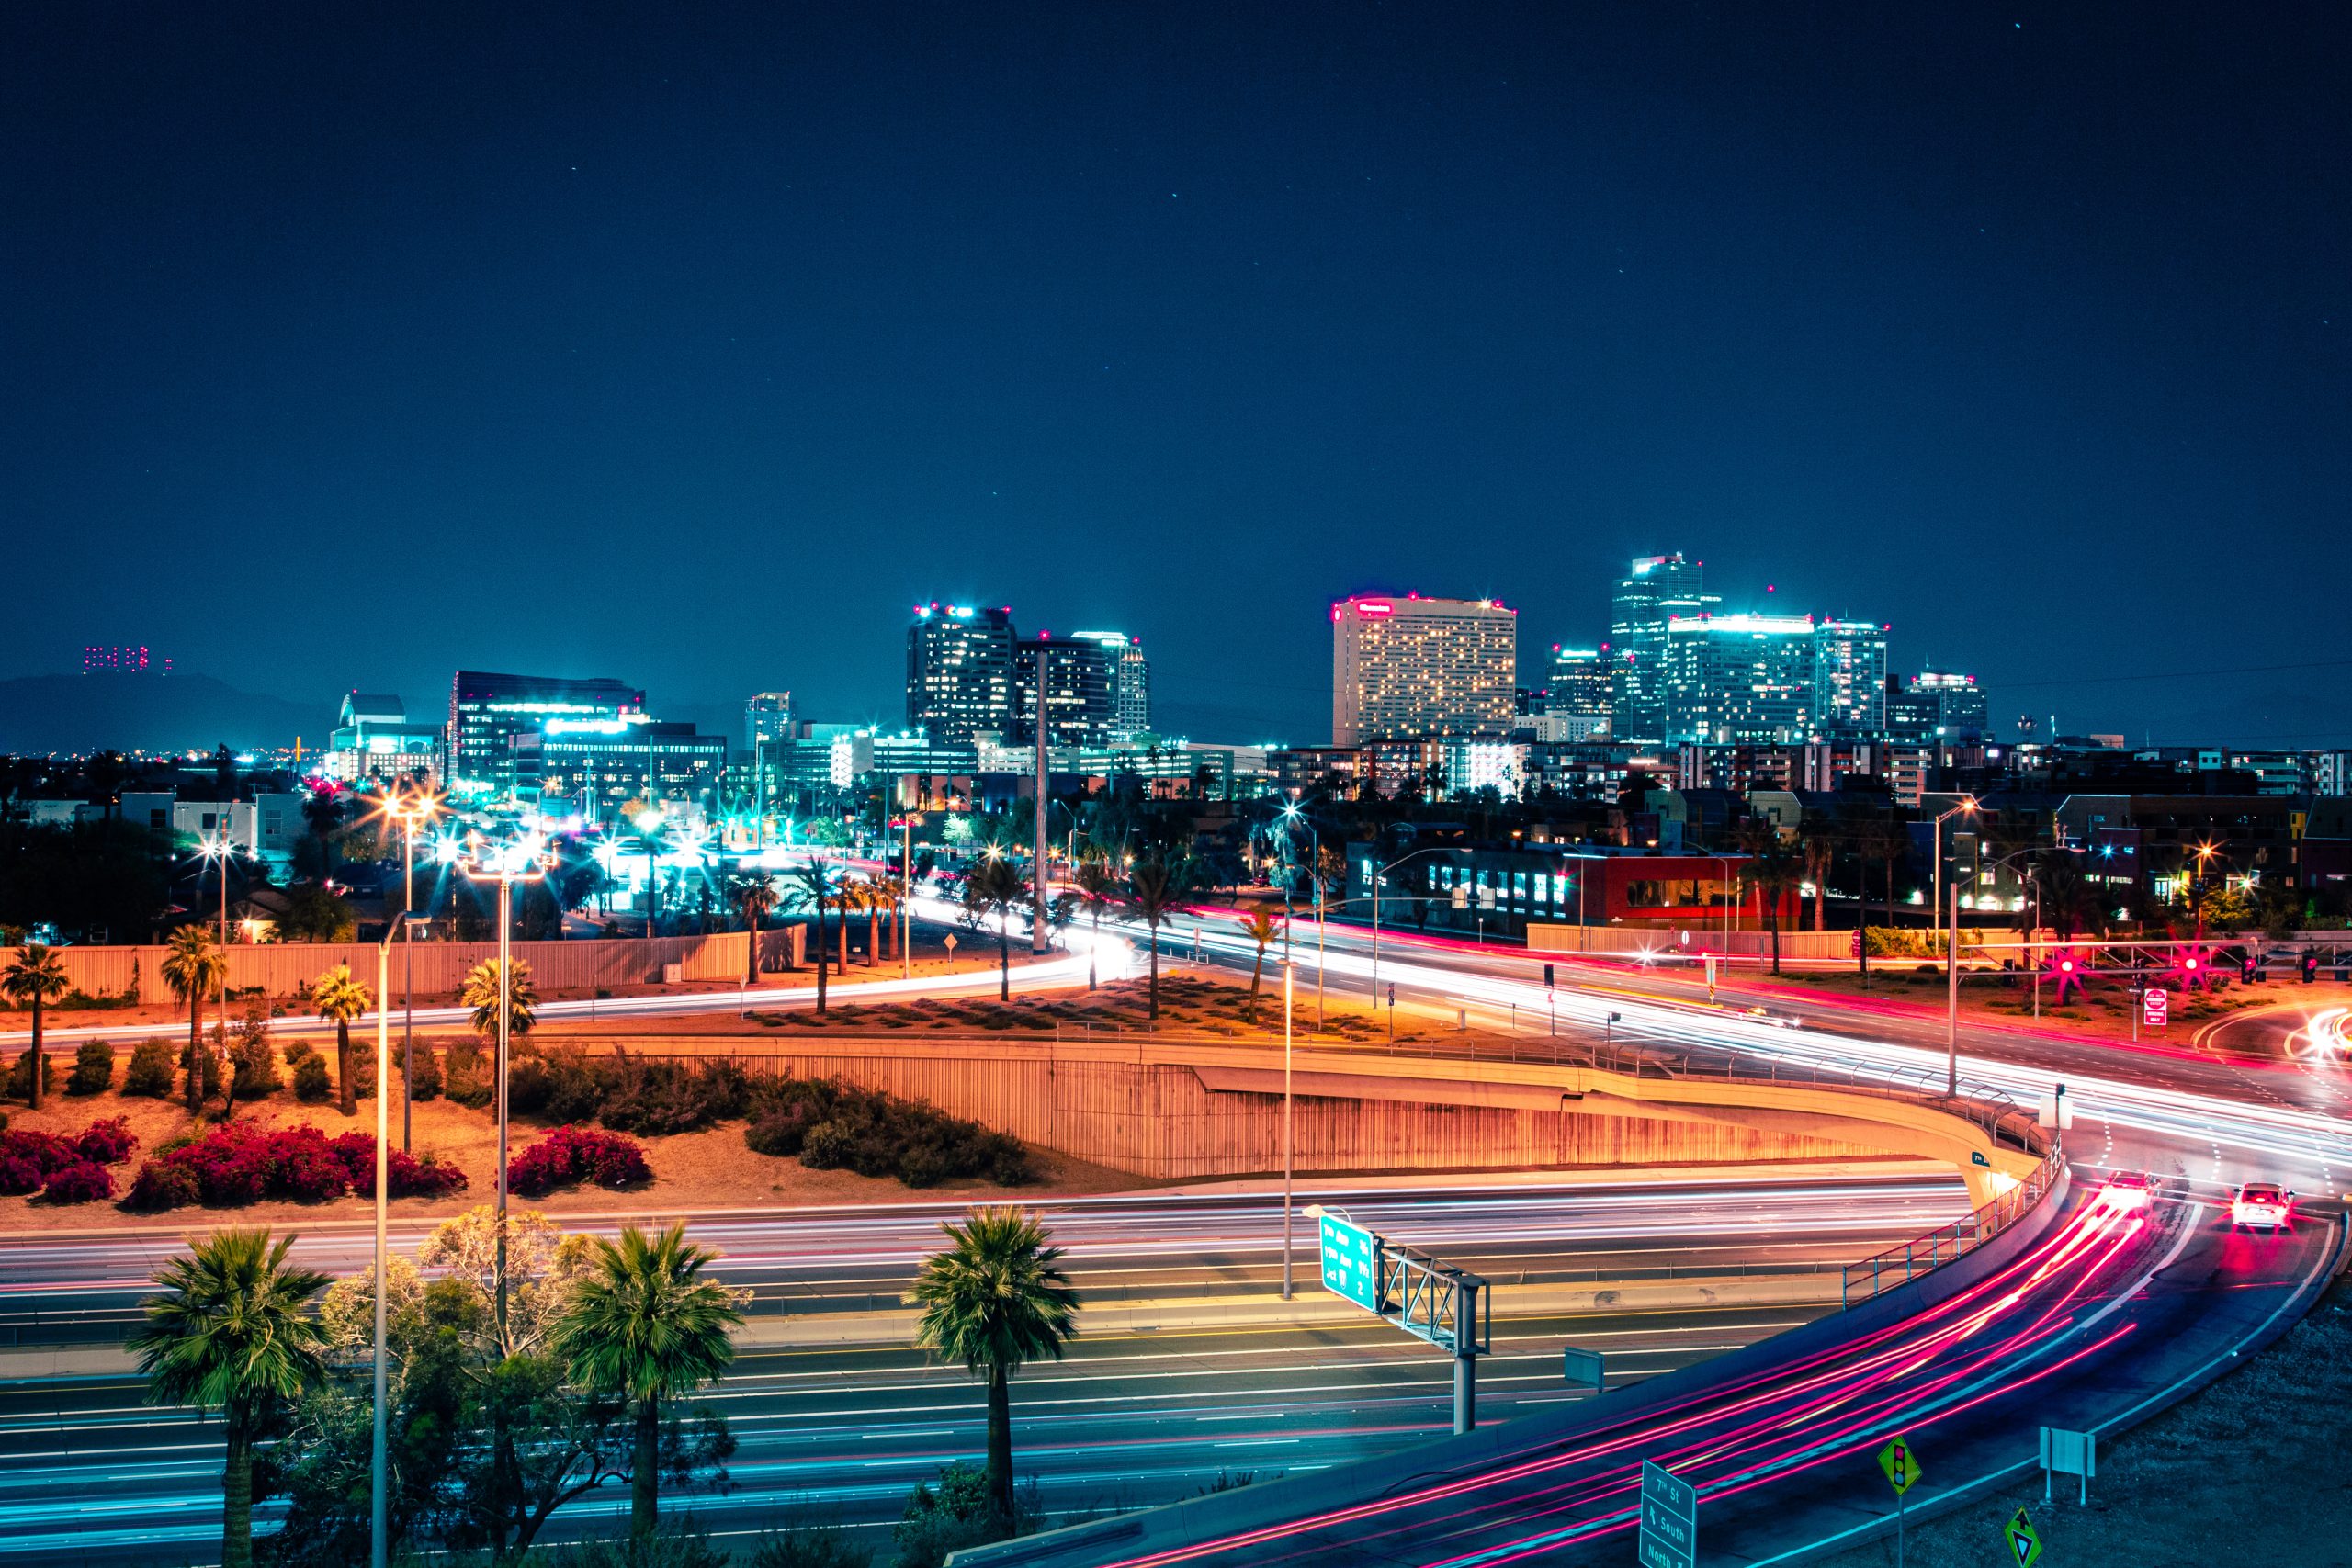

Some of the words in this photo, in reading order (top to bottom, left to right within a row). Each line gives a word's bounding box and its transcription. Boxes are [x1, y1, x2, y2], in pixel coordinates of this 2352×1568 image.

[1357, 1280, 1363, 1296] 2
[1670, 1487, 1679, 1504] St
[1660, 1517, 1684, 1543] South
[1648, 1543, 1671, 1568] North
